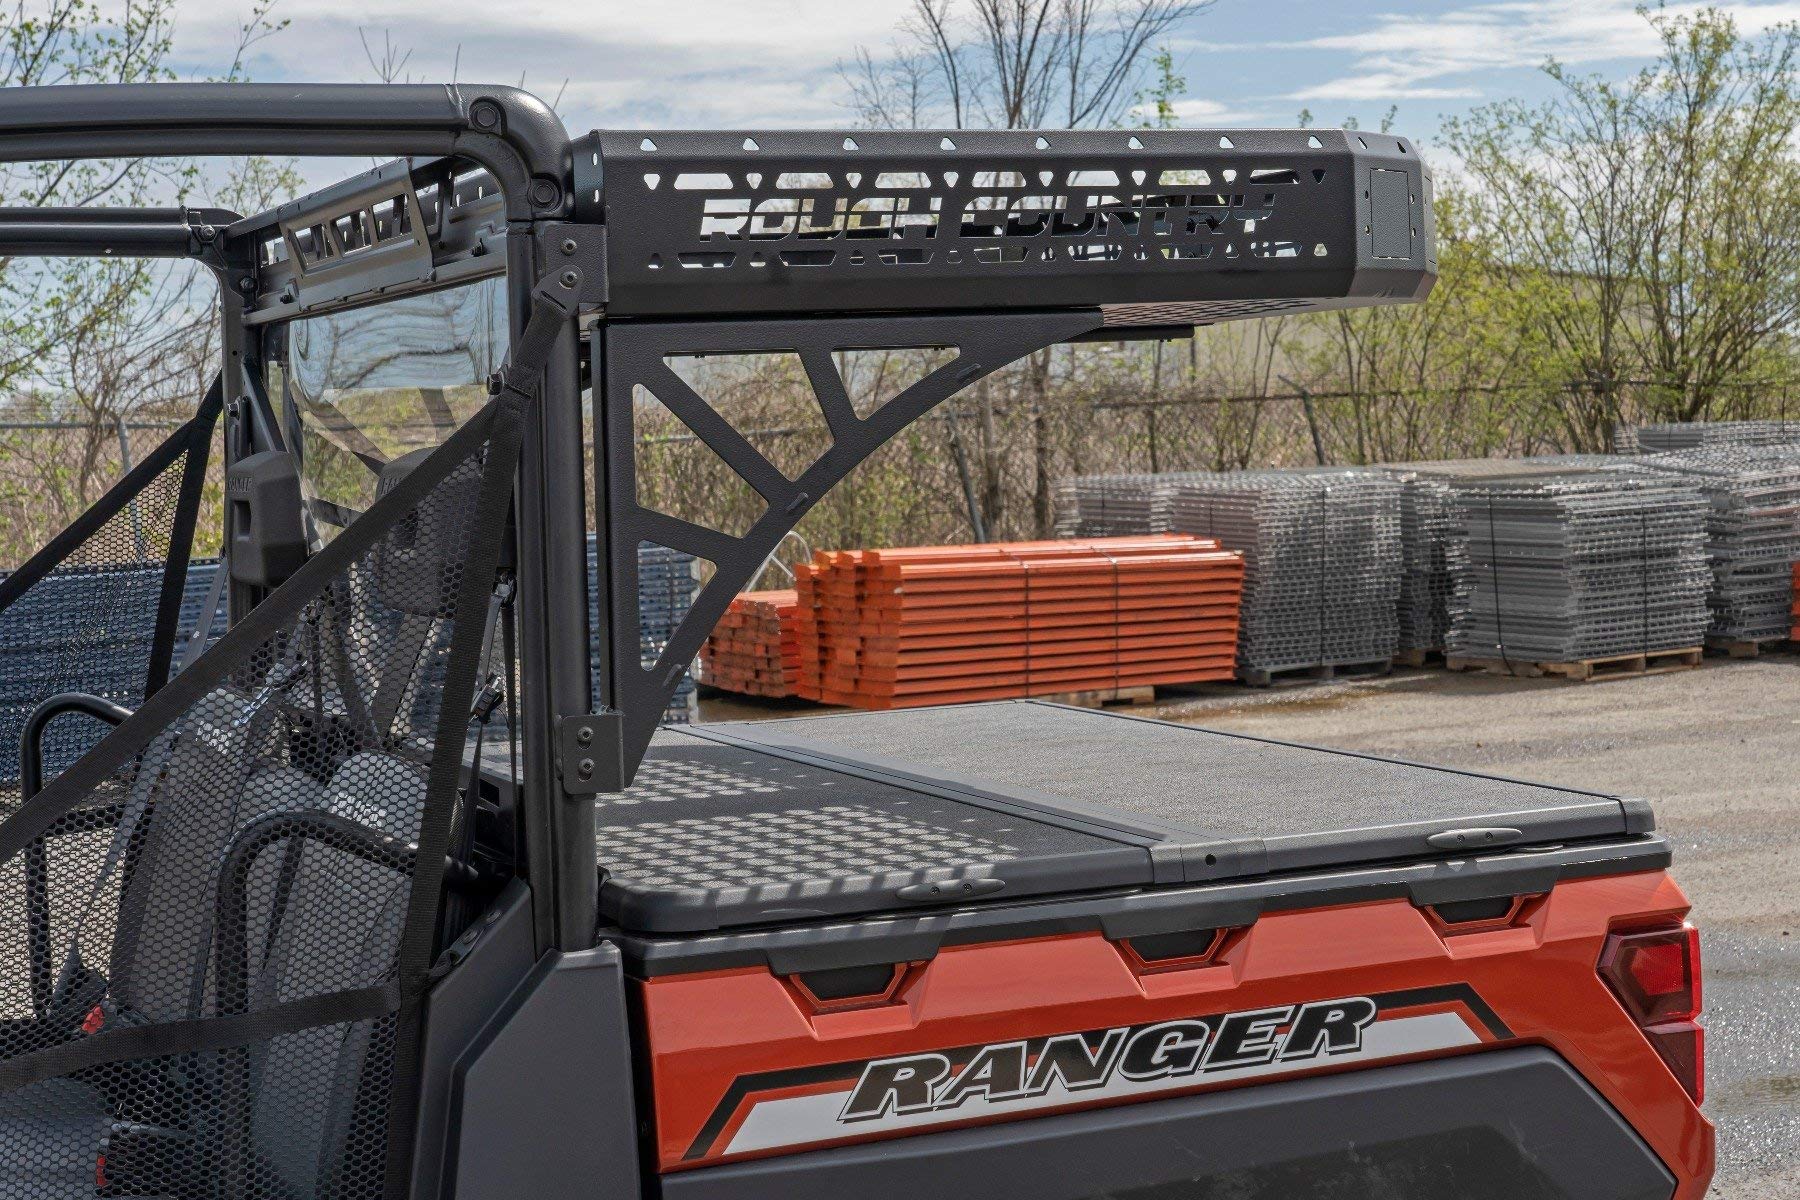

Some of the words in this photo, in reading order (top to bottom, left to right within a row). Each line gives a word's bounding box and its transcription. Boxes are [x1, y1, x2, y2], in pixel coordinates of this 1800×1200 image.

[700, 198, 942, 242] ROUGH
[959, 194, 1275, 238] COUNTRY
[836, 997, 1377, 1123] RANGER
